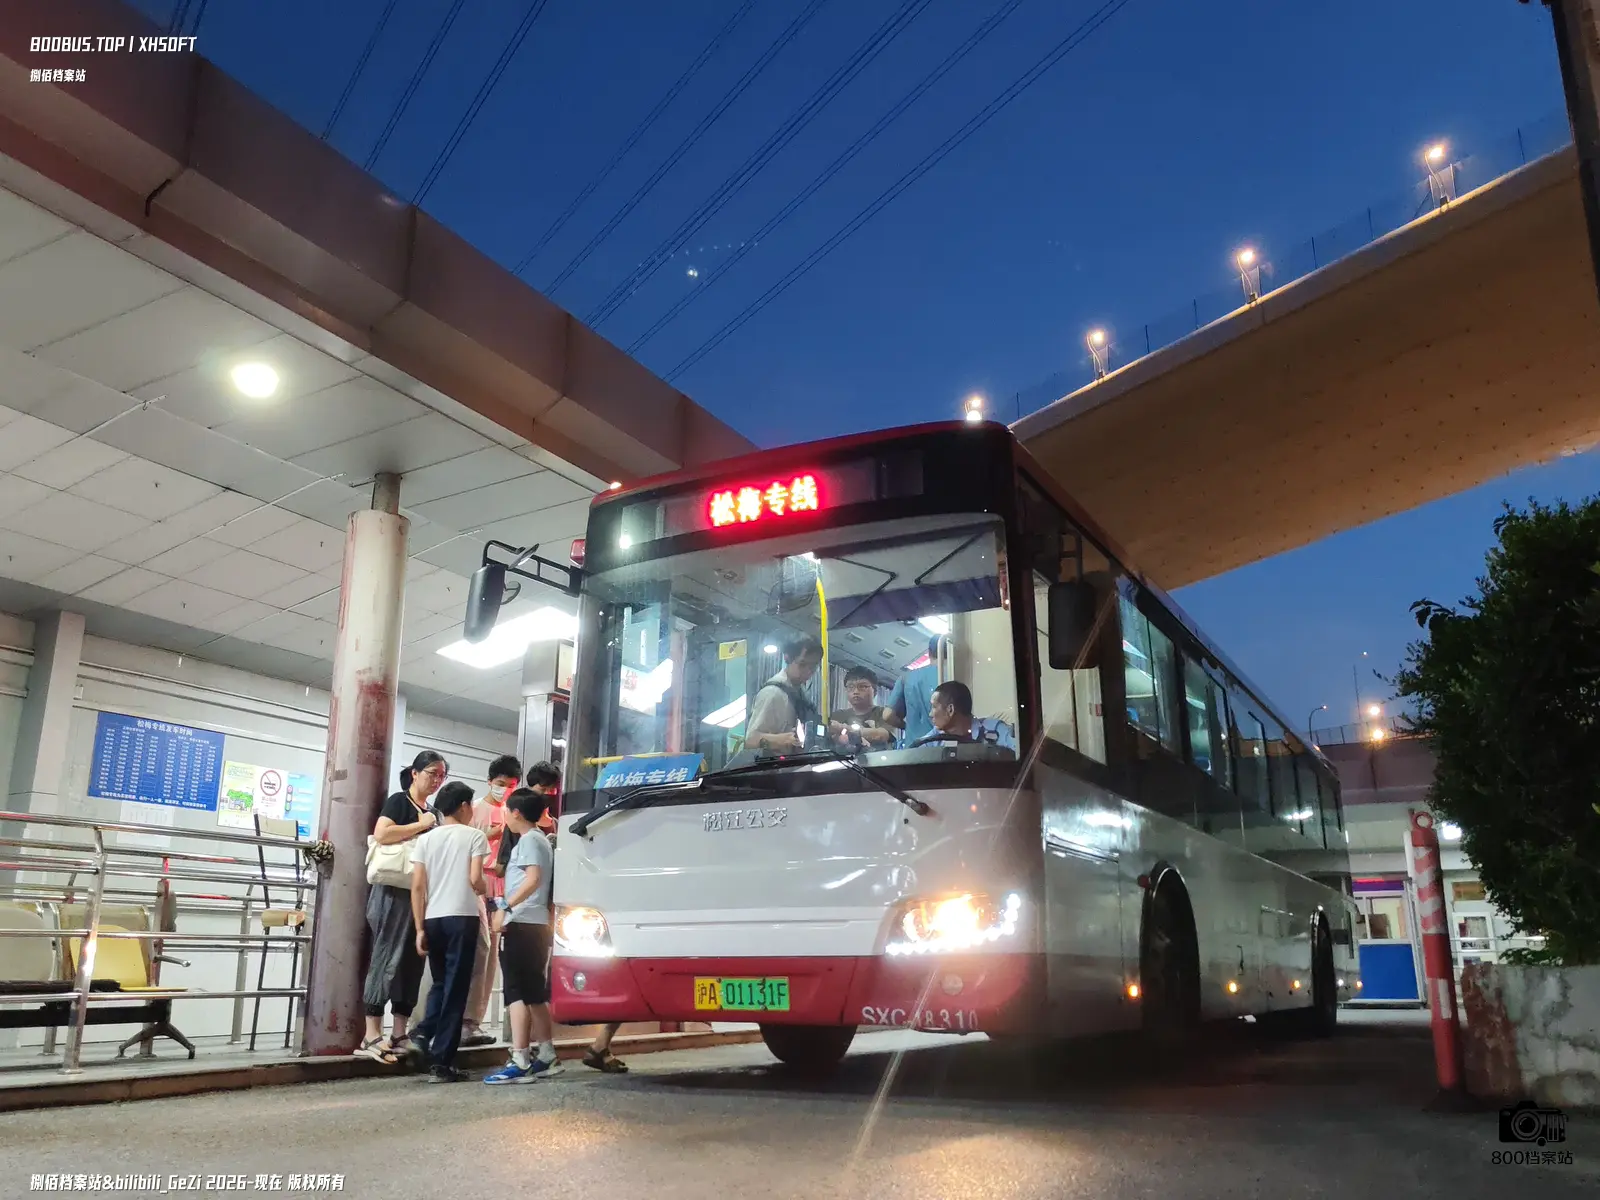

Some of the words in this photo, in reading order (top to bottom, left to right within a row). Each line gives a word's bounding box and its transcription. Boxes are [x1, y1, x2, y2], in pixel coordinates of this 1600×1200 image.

[710, 475, 818, 527] 松梅专线
[603, 767, 689, 789] 松梅专线
[702, 807, 787, 832] 松江公交
